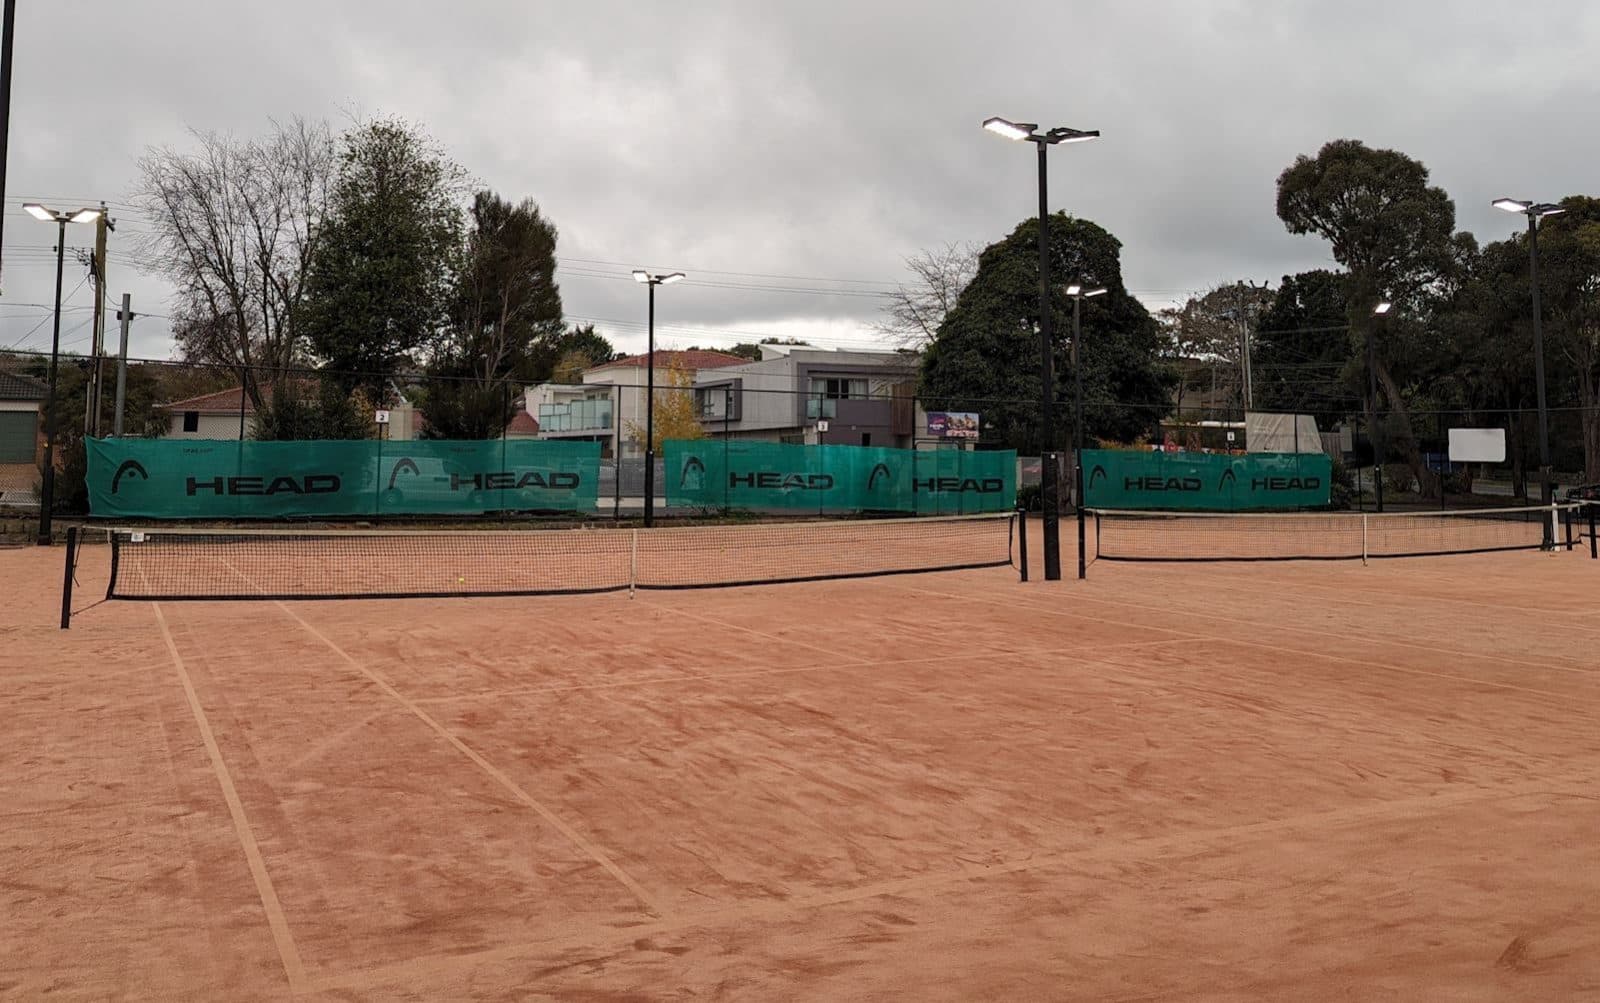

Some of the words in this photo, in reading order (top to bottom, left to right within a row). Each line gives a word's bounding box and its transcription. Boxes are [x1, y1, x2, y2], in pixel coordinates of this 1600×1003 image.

[186, 474, 341, 496] HEAD
[450, 472, 580, 490] HEAD
[730, 472, 833, 490] HEAD
[913, 477, 1003, 493] HEAD
[1124, 477, 1202, 491] HEAD
[1251, 477, 1320, 490] HEAD
